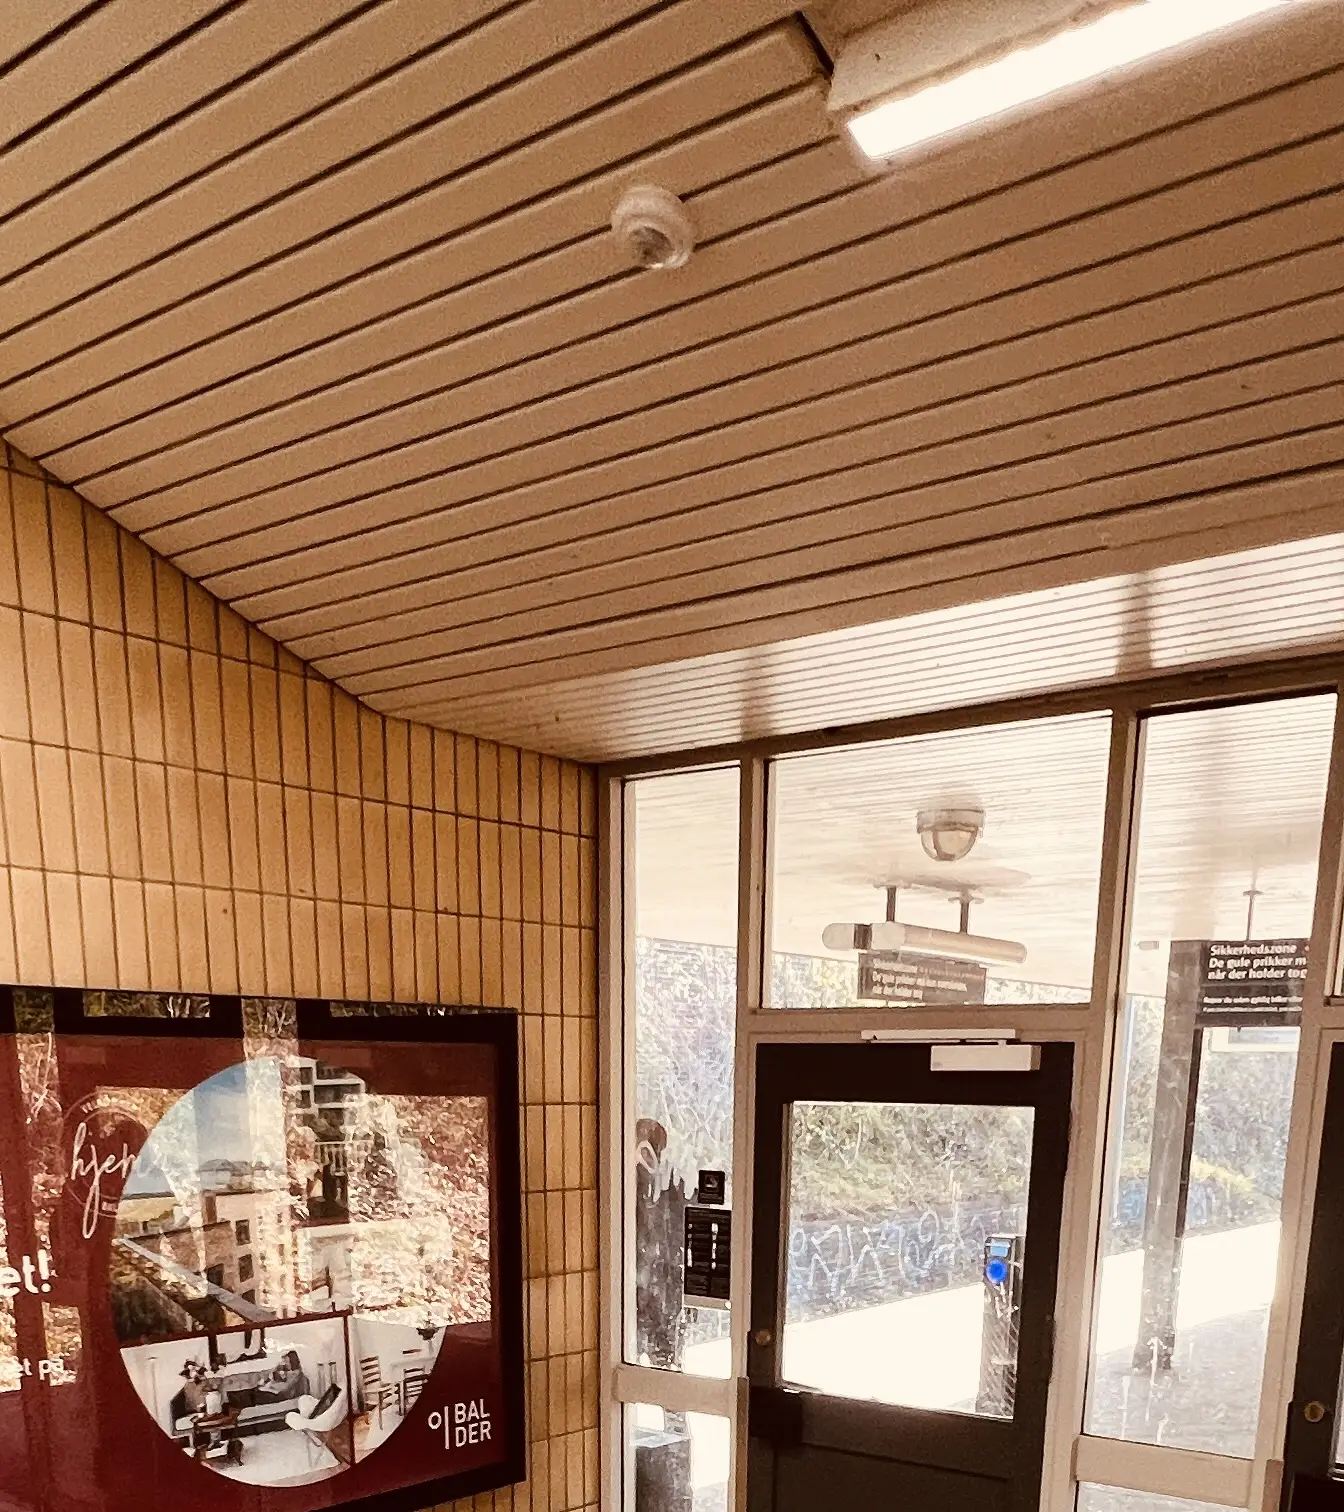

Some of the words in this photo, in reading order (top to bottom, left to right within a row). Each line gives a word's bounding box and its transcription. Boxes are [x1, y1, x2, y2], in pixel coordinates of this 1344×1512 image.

[1210, 944, 1297, 957] Sikkerhedszone
[1208, 958, 1224, 969] De
[1227, 957, 1251, 969] gule
[1253, 956, 1294, 969] prikker
[1207, 969, 1226, 980] når
[1228, 969, 1248, 980] der
[1248, 968, 1286, 979] holder
[454, 1398, 490, 1424] BAL
[455, 1420, 492, 1447] DER
